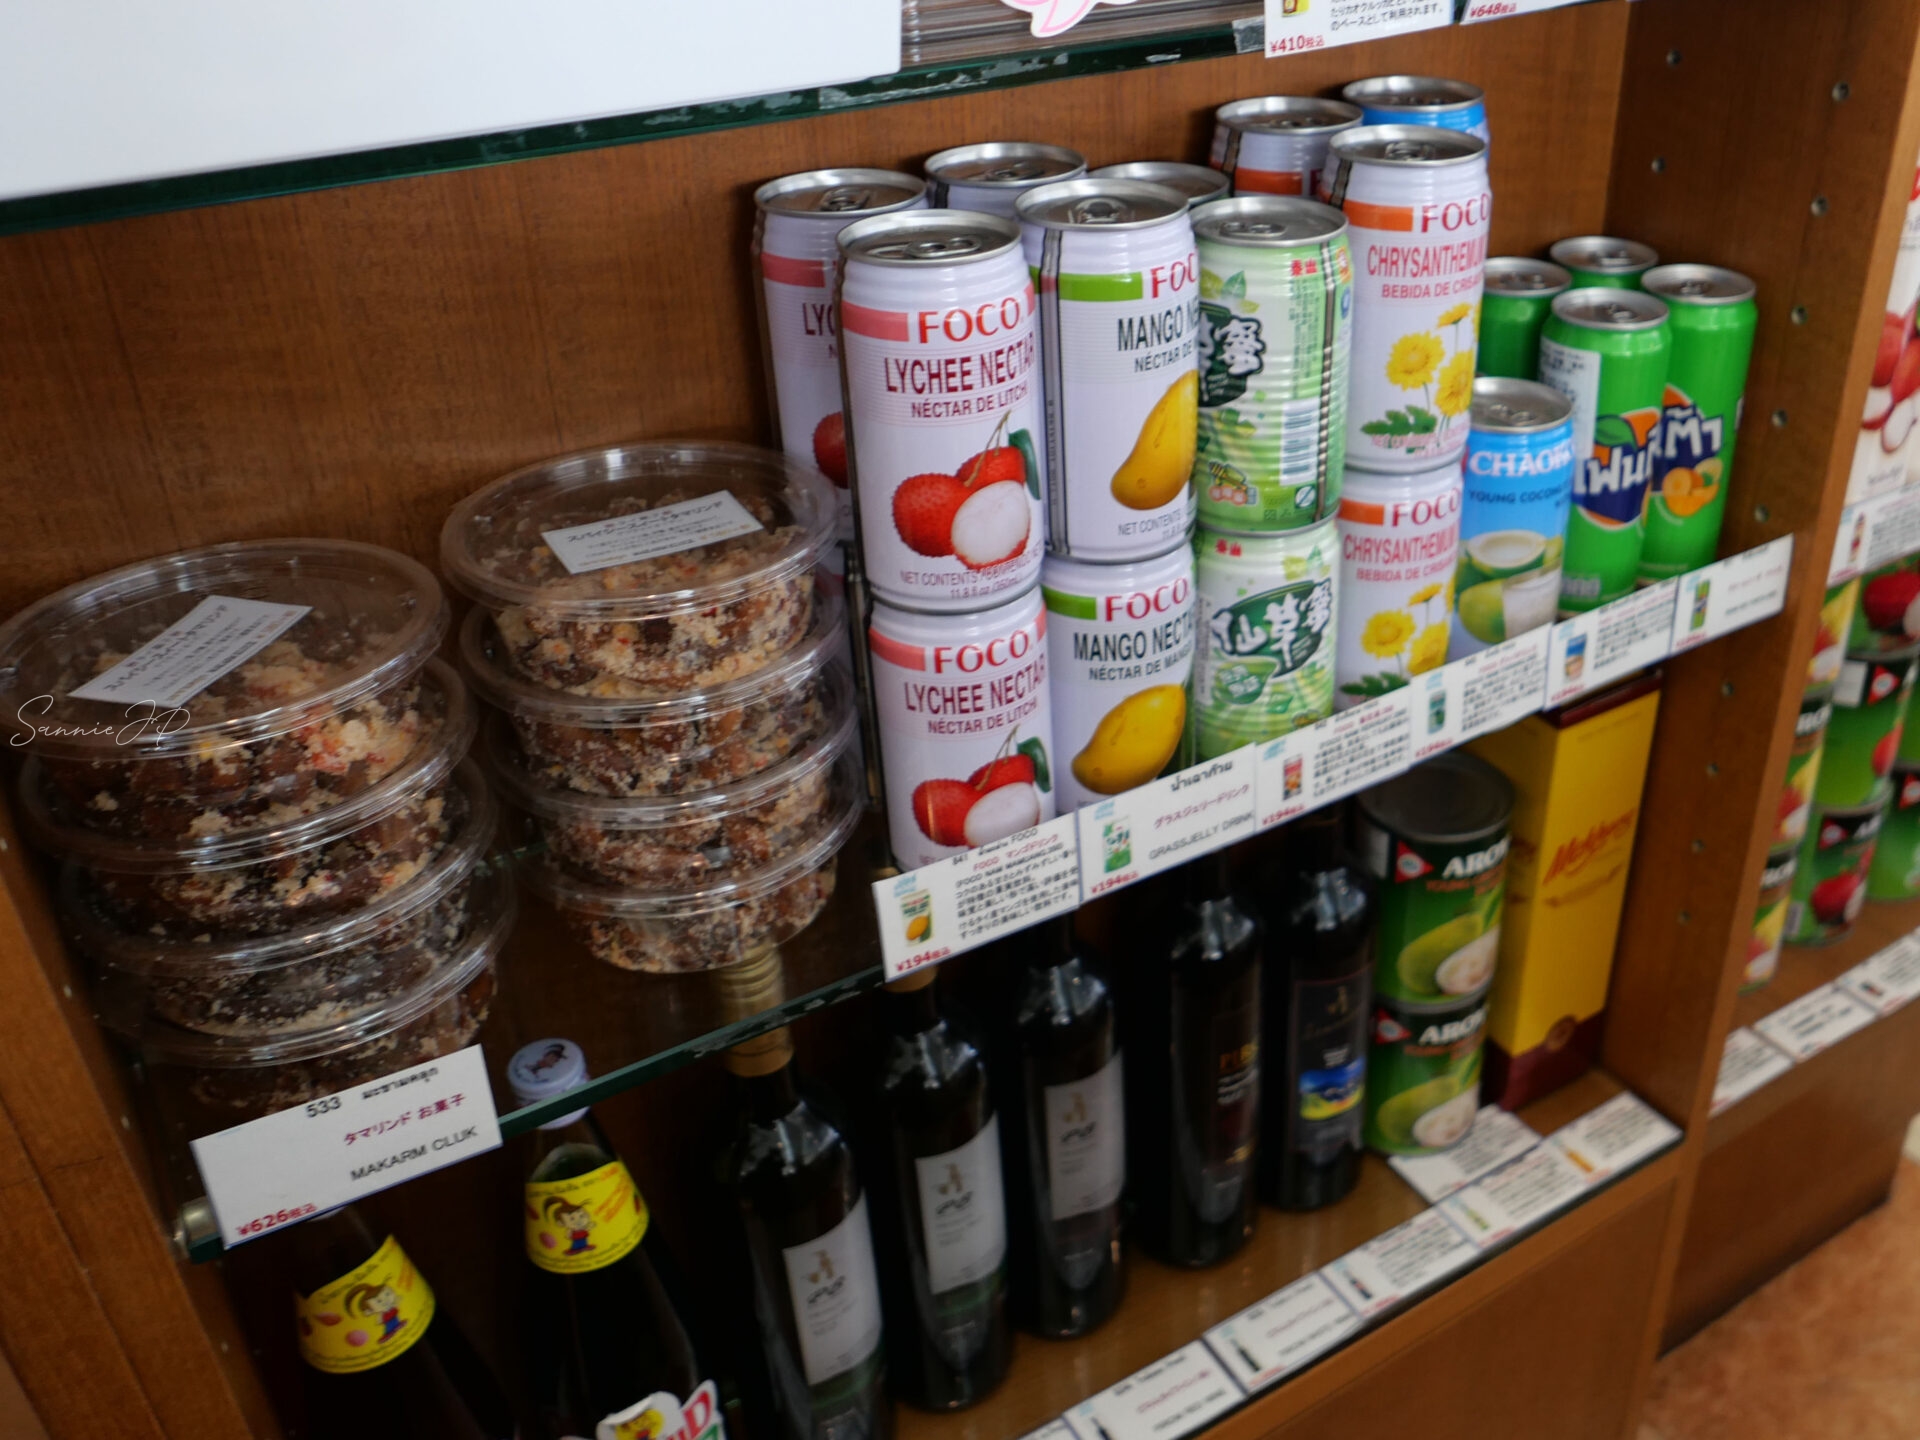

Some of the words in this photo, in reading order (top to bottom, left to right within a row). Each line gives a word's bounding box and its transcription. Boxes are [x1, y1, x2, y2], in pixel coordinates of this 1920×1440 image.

[1421, 193, 1489, 233] FOCO
[1381, 283, 1431, 299] BEBIDA
[1434, 281, 1450, 297] DE
[918, 297, 1021, 344] FOCO
[1118, 304, 1183, 352] MANGO
[884, 356, 974, 394] LYCHEE
[911, 398, 973, 418] NÉCTAR
[976, 394, 995, 412] DE
[1105, 577, 1188, 622] FOCO
[933, 630, 1030, 673] FOCO
[1073, 630, 1147, 661] MANGO
[1089, 664, 1142, 681] NÉCTAR
[1145, 659, 1161, 675] DE
[904, 682, 984, 715] LYCHEE
[928, 717, 983, 734] NÉCTAR
[987, 714, 1004, 729] DE
[305, 1095, 342, 1118] 533
[344, 1110, 412, 1146] タマリンド
[418, 1092, 466, 1120] お菓子
